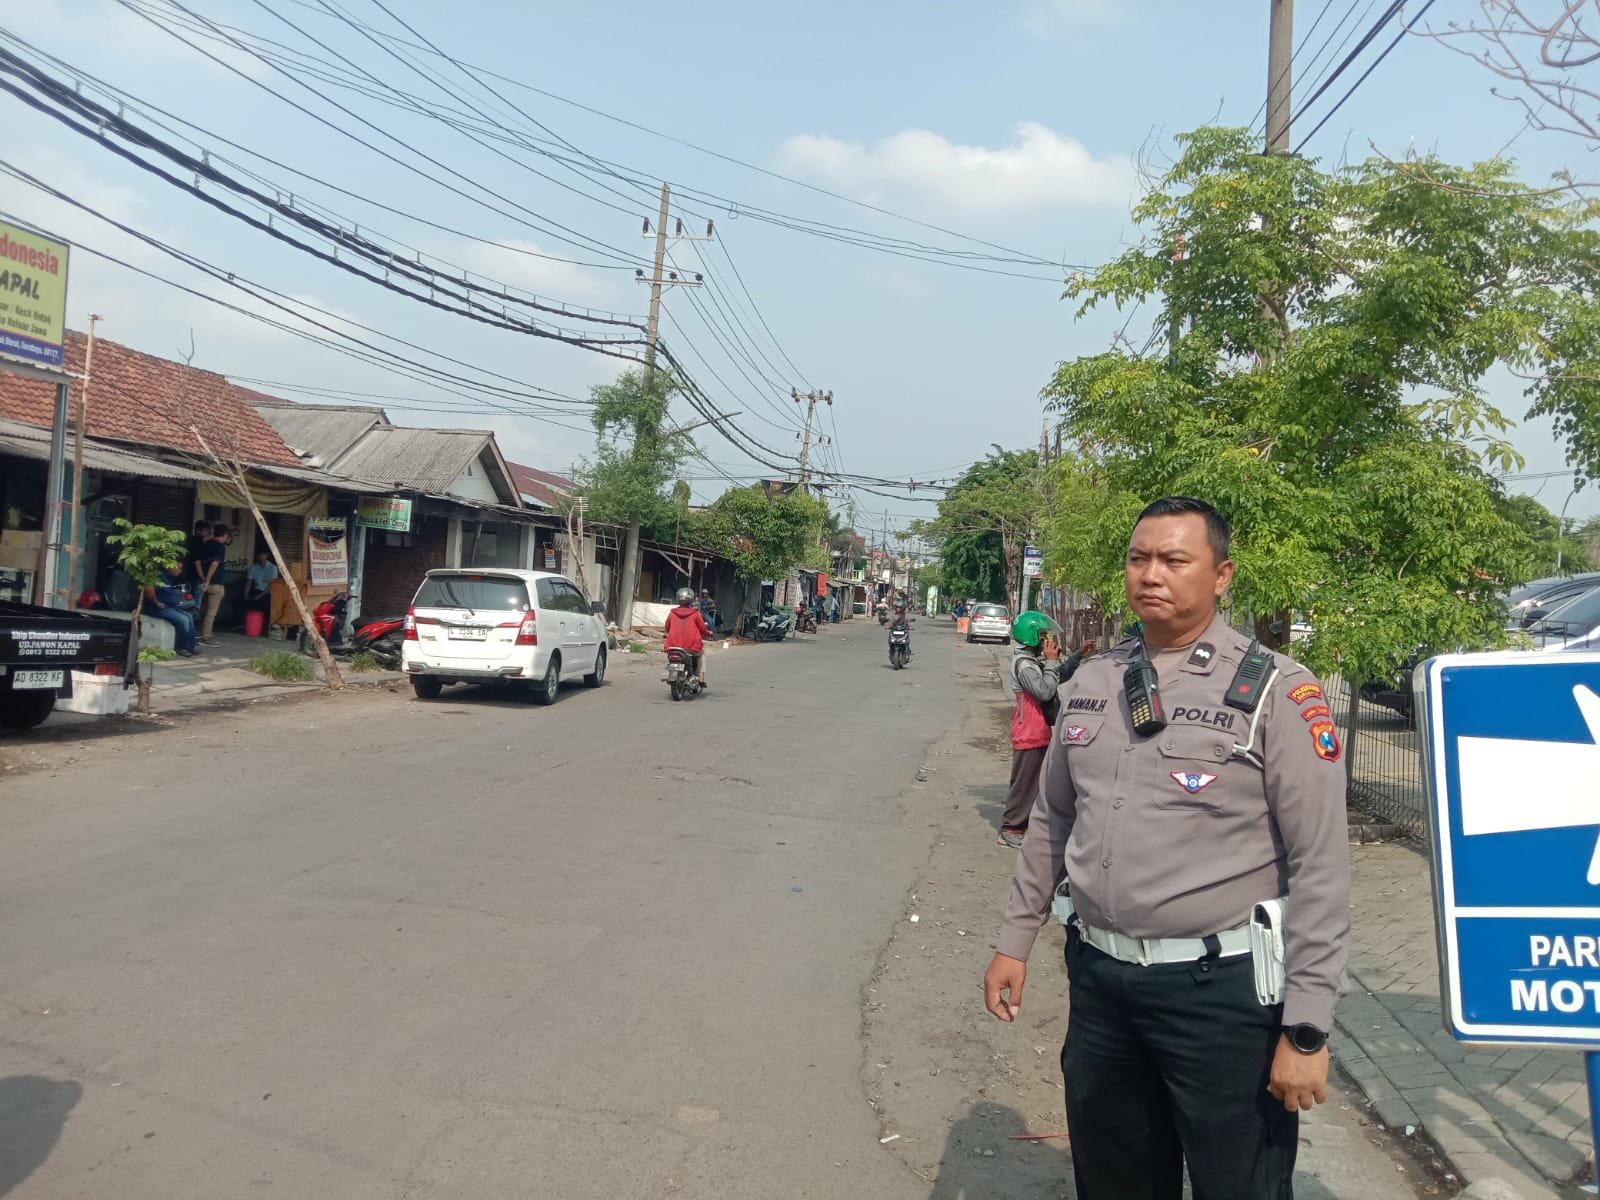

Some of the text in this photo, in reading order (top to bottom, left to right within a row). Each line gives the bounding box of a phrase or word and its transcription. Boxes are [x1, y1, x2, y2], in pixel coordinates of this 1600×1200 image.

[0, 232, 58, 276] donesia
[0, 269, 40, 301] APAL
[15, 672, 26, 682] AD
[29, 672, 48, 682] 8322
[1171, 706, 1236, 729] POLRI
[1529, 935, 1600, 968] PAR
